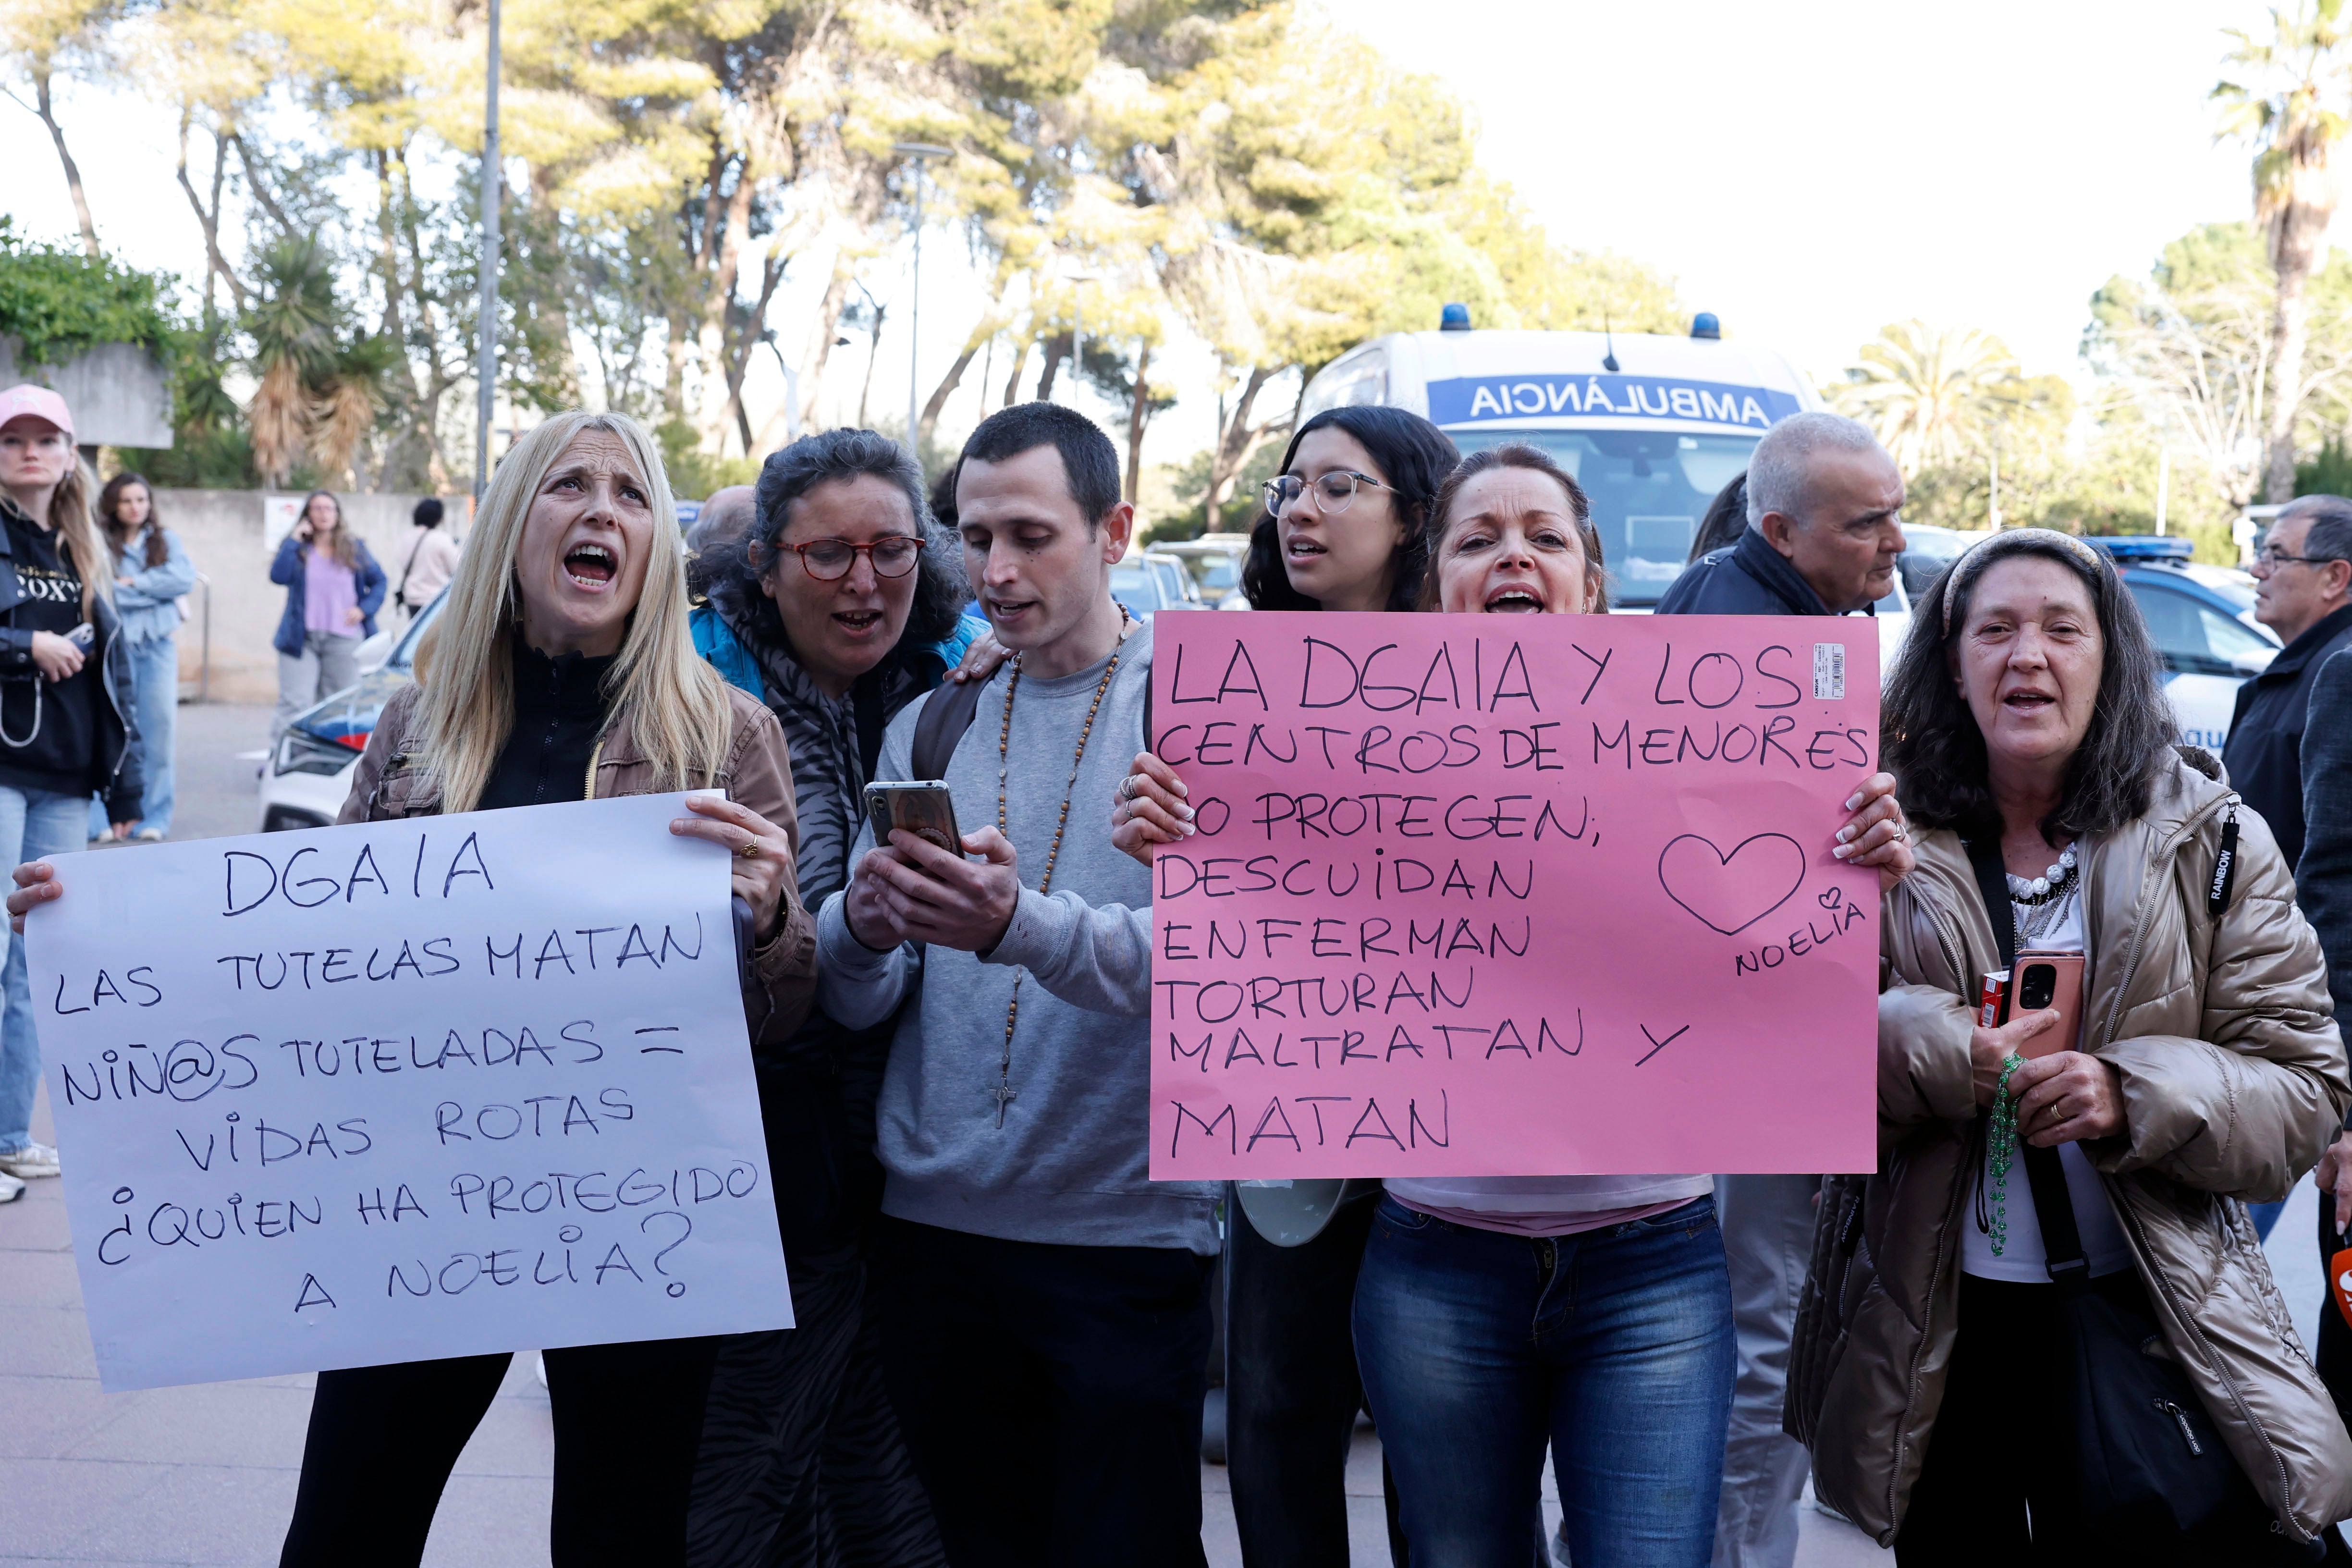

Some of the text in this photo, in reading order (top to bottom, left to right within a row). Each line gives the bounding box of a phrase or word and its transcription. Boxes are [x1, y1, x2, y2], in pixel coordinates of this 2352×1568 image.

[1171, 638, 1269, 711] LA
[1298, 636, 1540, 716] DGAIA
[1571, 644, 1613, 705] Y
[1654, 643, 1801, 709] LOS
[1157, 715, 1868, 774] CENTROS DE MENORES
[1184, 796, 1230, 836] O
[222, 832, 493, 917] DGAIA
[2211, 850, 2231, 900] RAINBOW
[1163, 916, 1531, 963] ENFERMAN
[1736, 887, 1866, 977] NOELIA
[55, 911, 702, 1015] LAS TUTELAS MATAN
[1155, 966, 1473, 1023] TORTURAN
[280, 1020, 603, 1078] TUTELADAS
[635, 1027, 684, 1054] =
[1170, 1008, 1690, 1073] MALTRATAN Y
[436, 1089, 633, 1145] ROTAS
[1171, 1089, 1449, 1158] MATAN
[357, 1183, 429, 1225] HA
[451, 1160, 758, 1219] PROTEGIDO
[294, 1273, 336, 1313] A
[2180, 1415, 2200, 1452] don algodon
